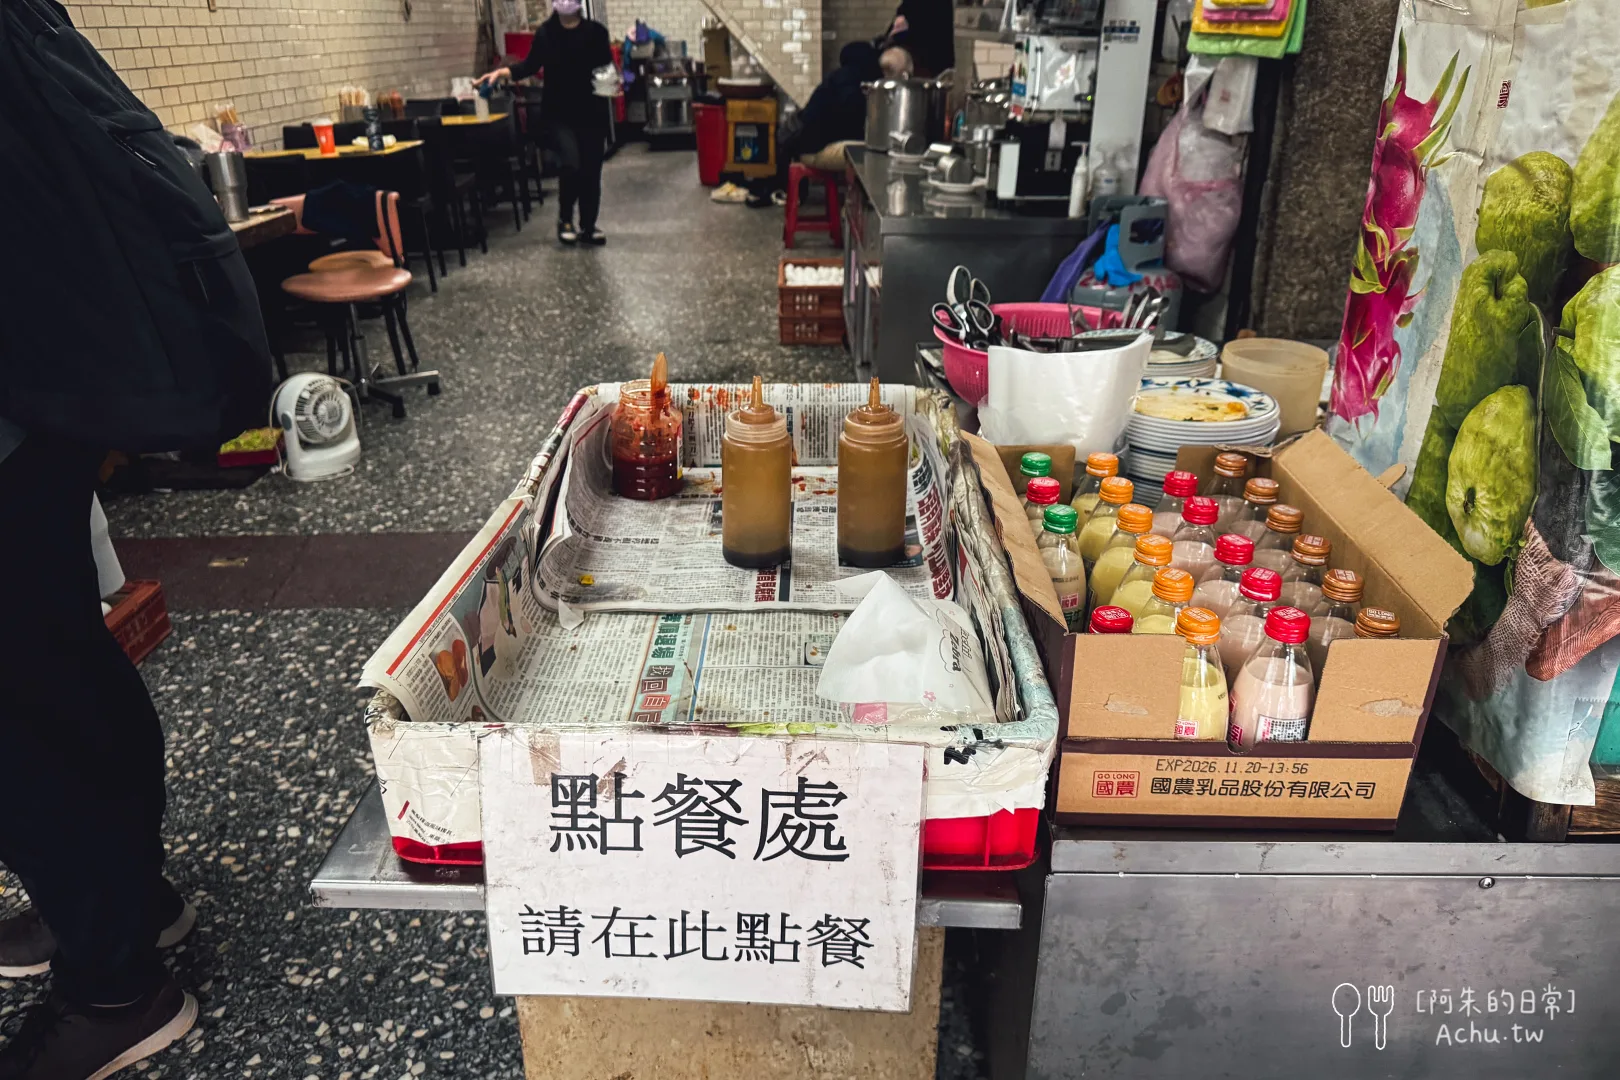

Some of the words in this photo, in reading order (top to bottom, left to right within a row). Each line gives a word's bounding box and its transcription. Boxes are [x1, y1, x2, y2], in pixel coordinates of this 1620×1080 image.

[1097, 772, 1110, 780] GO
[1155, 758, 1309, 776] EXP2026.11.20-13:56
[1095, 781, 1136, 798] 國農
[1150, 776, 1377, 800] 國農乳品股份有限公司
[548, 771, 851, 863] 點餐處
[517, 903, 875, 970] 請在此點餐
